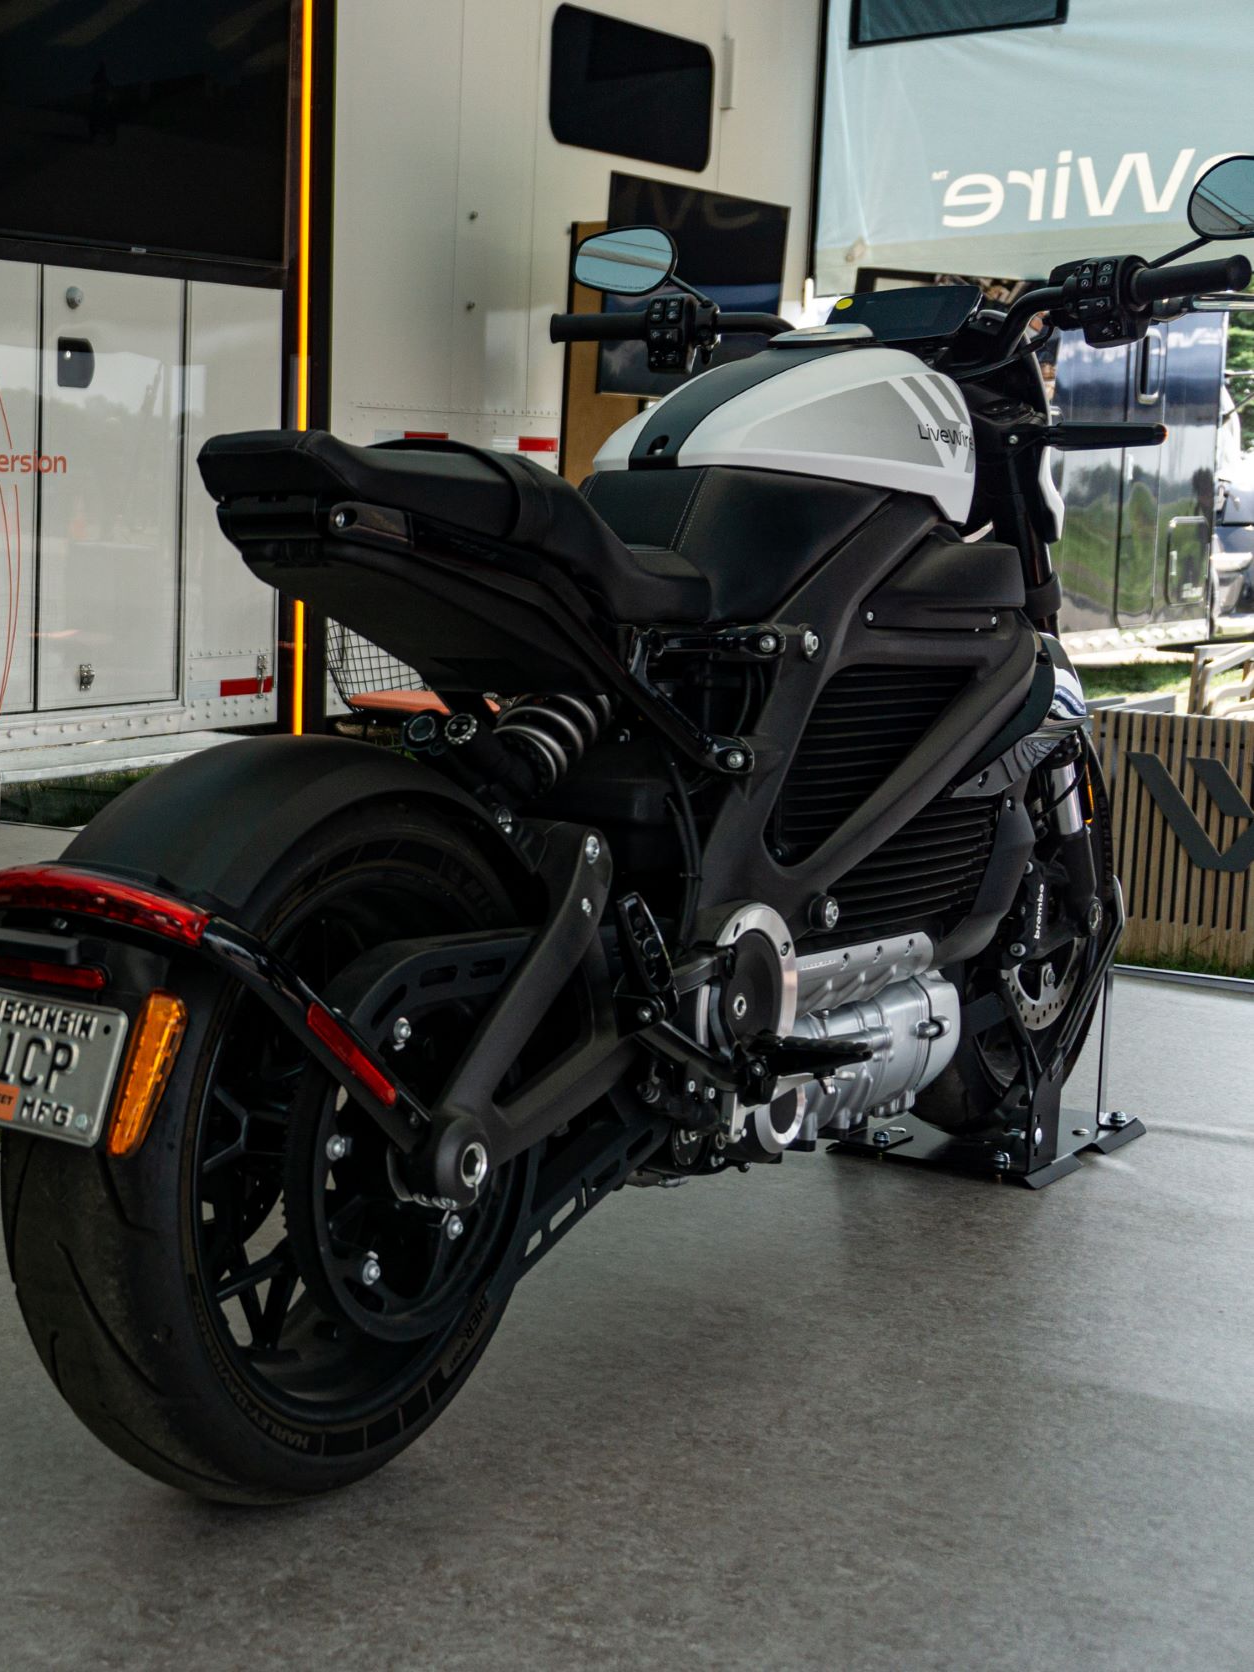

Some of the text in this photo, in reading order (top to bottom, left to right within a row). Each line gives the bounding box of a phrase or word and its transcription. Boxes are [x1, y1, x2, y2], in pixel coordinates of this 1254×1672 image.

[918, 423, 974, 451] LiveWire
[1033, 883, 1045, 940] brembo
[21, 1096, 74, 1127] MFG
